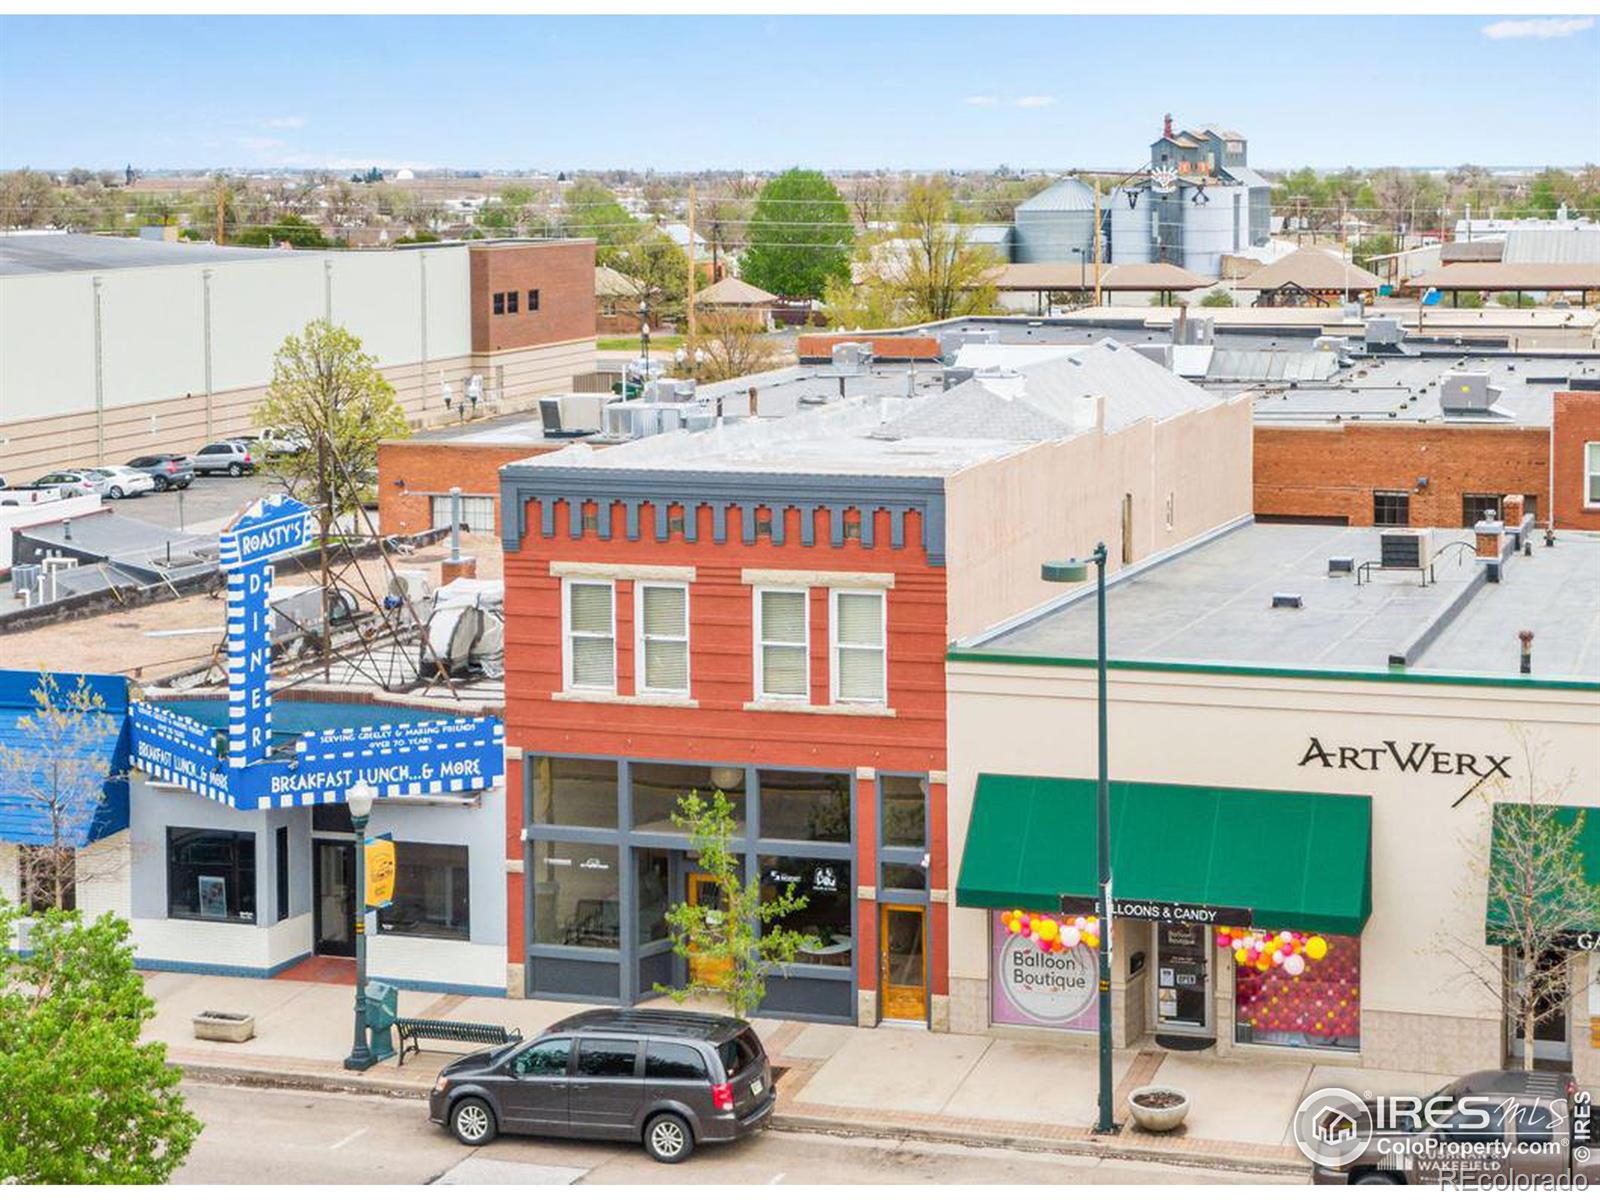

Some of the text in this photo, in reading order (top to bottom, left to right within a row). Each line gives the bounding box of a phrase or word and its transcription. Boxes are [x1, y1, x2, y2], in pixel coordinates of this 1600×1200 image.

[242, 522, 301, 556] ROASTY'S
[250, 573, 263, 748] DINER
[271, 769, 353, 794] BREAKFAST
[440, 758, 481, 778] MORE
[1162, 906, 1172, 918] &
[1174, 907, 1217, 922] CANDY
[1013, 951, 1076, 970] Balloon
[1013, 968, 1086, 991] Boutique
